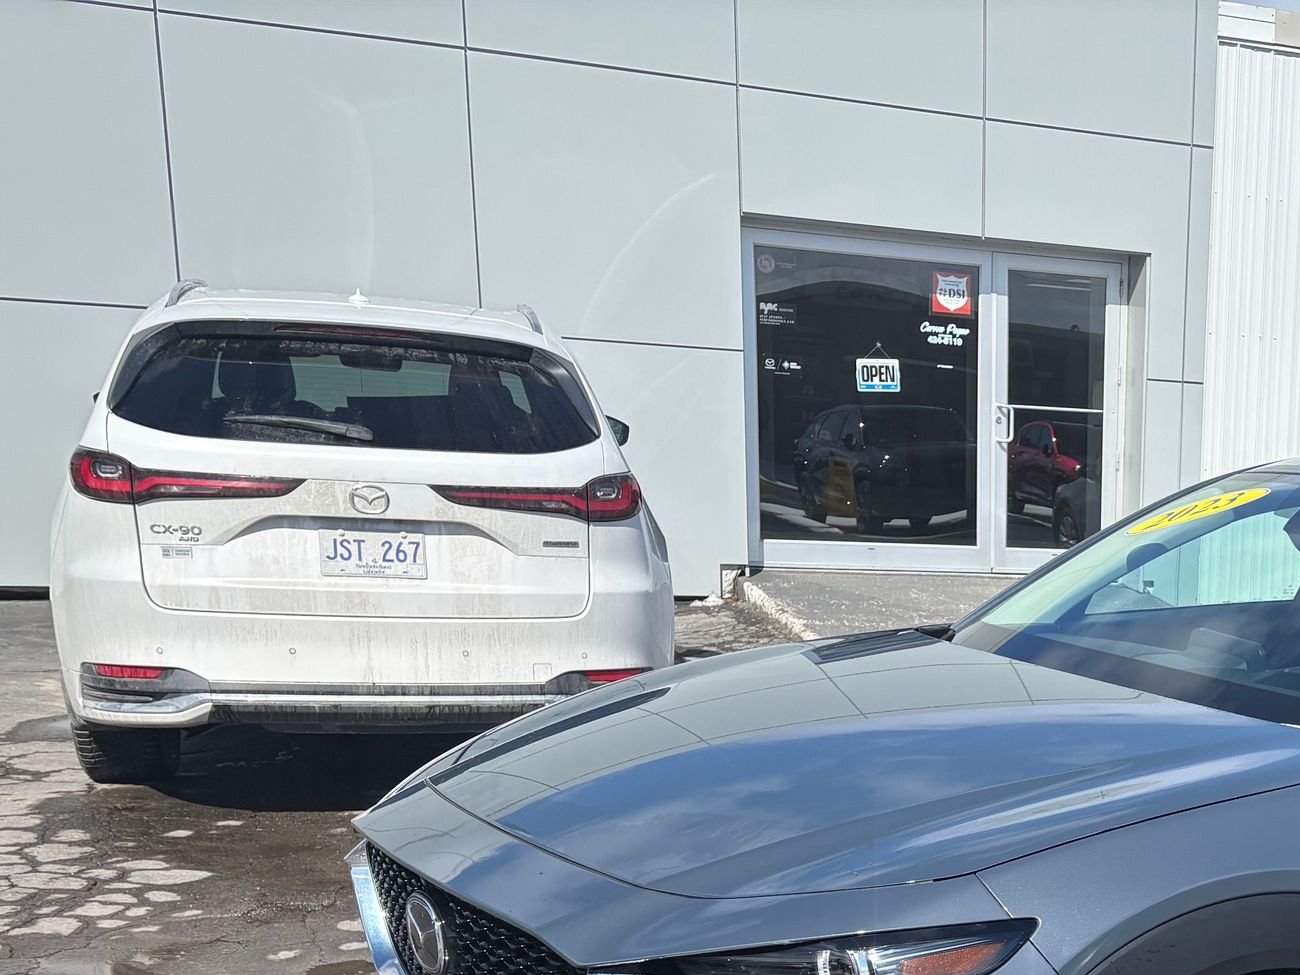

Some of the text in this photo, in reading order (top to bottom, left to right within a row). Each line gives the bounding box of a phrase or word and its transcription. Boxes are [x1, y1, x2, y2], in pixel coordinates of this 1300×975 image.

[861, 364, 896, 383] OPEN
[1140, 491, 1246, 531] 2023
[150, 524, 203, 536] CX-90
[326, 537, 421, 564] JST 267
